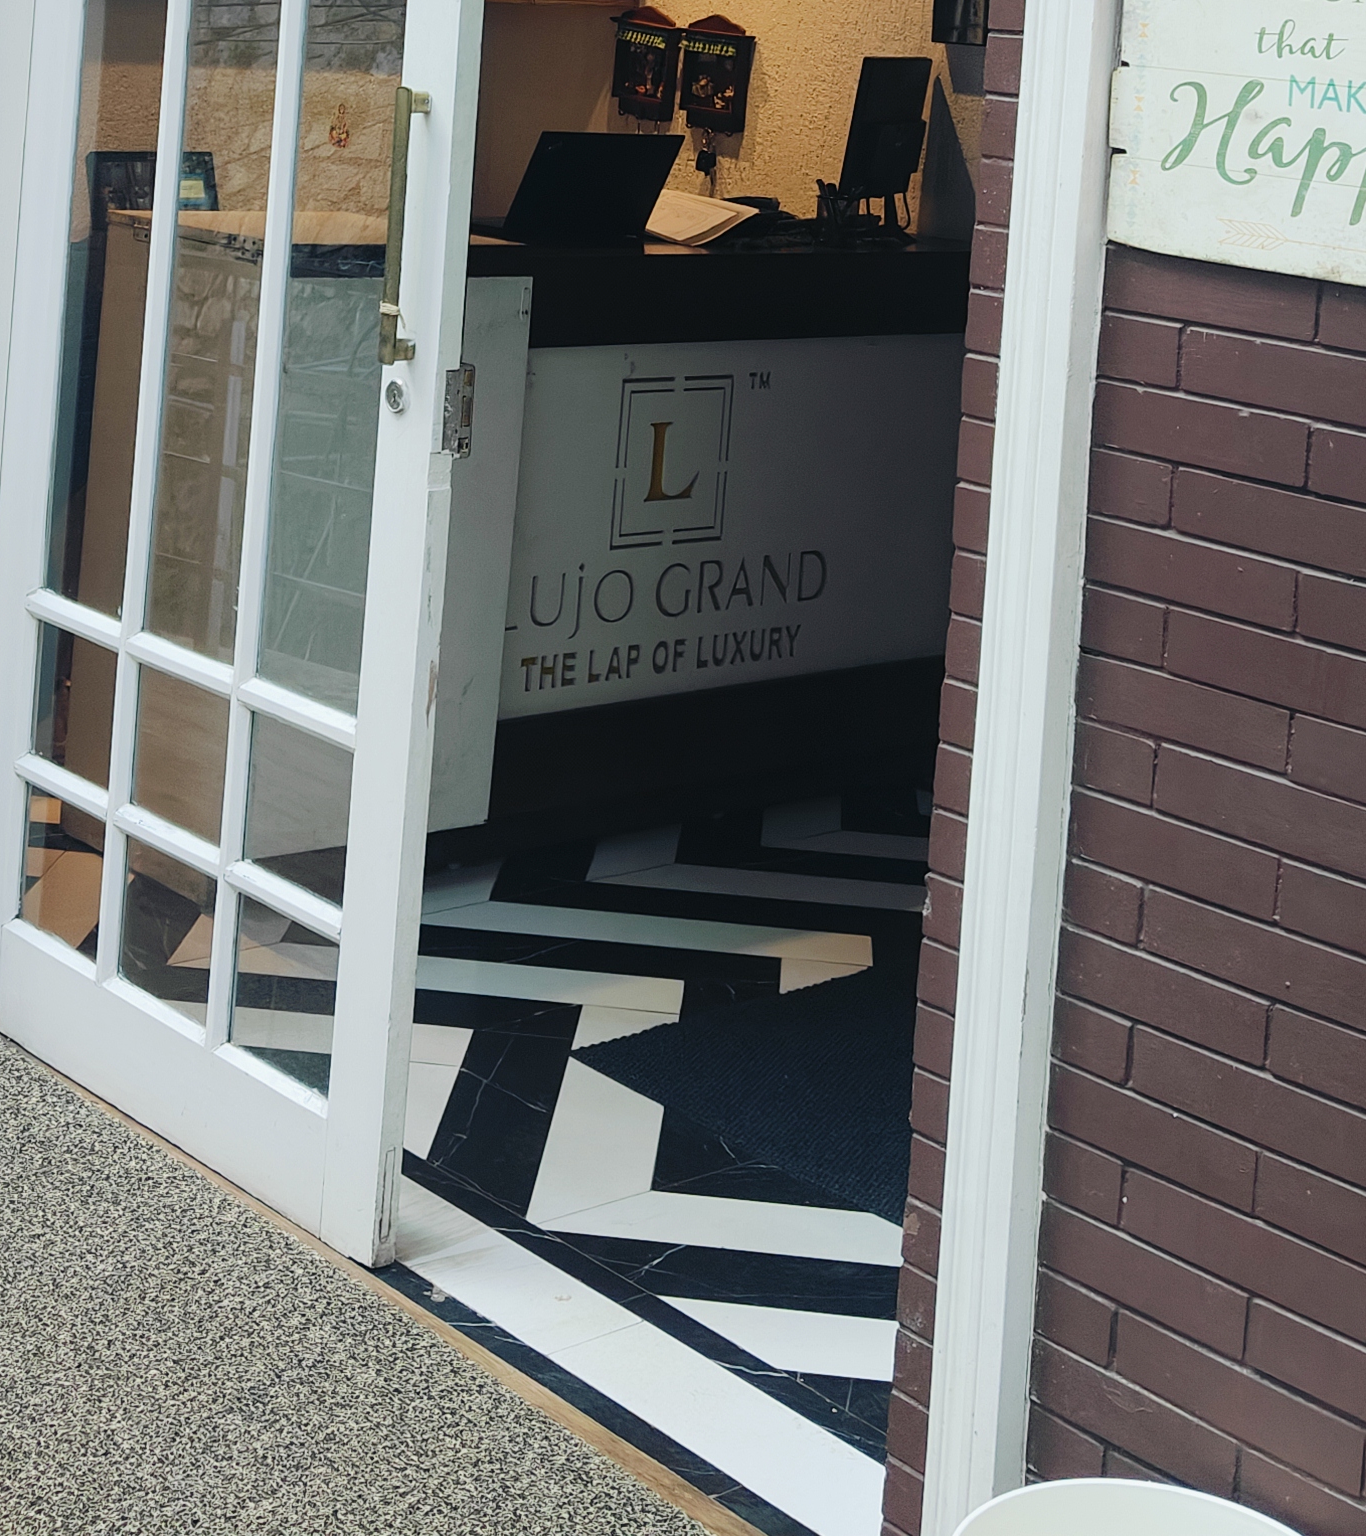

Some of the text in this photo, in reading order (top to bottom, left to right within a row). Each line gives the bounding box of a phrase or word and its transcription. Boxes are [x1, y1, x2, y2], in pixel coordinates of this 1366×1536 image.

[1254, 19, 1349, 61] that
[748, 371, 772, 390] TM
[643, 420, 700, 503] L
[655, 549, 828, 618] GRAND
[520, 624, 802, 693] THE LAP OF LUXURY
